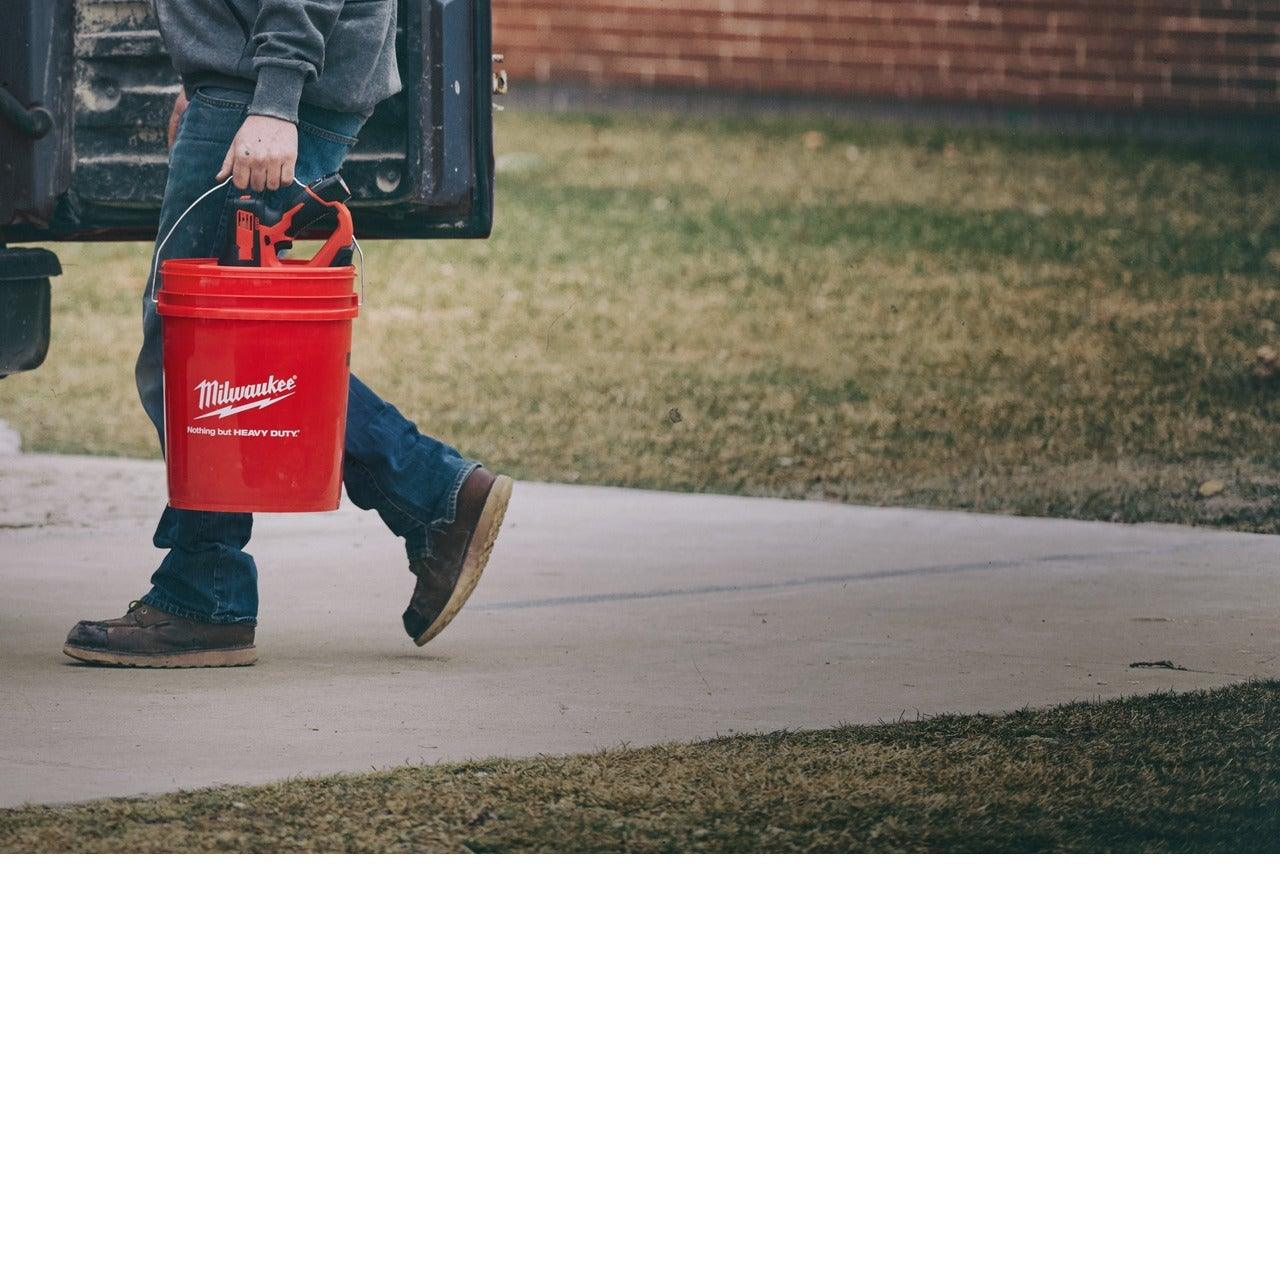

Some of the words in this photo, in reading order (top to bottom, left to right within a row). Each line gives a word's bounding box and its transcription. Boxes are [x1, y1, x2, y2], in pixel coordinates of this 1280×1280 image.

[194, 375, 296, 409] Milwaukee
[187, 426, 215, 436] Nothing
[218, 428, 232, 436] but
[234, 429, 268, 437] HEAVY
